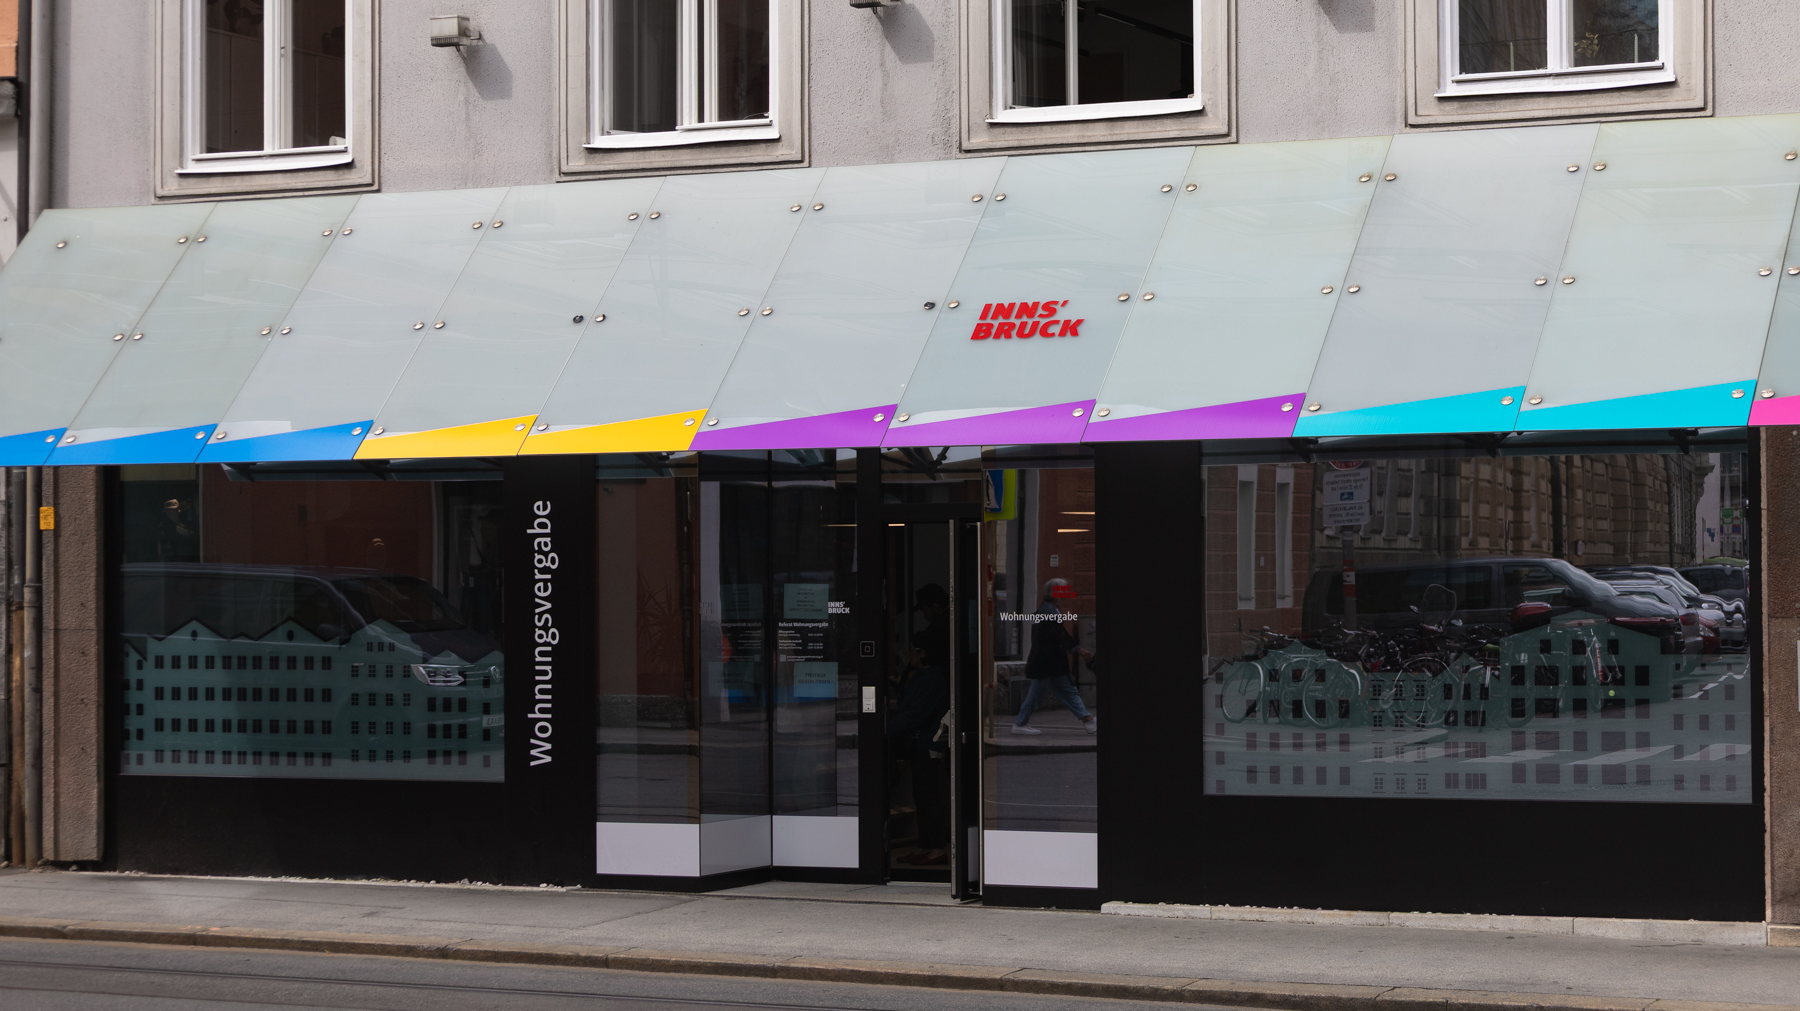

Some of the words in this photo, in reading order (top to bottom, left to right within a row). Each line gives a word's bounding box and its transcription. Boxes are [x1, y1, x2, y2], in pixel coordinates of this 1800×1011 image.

[970, 319, 1085, 340] BRUCK
[1000, 611, 1078, 624] Wohnungsvergabe
[527, 501, 559, 766] Wohnungsvergabe
